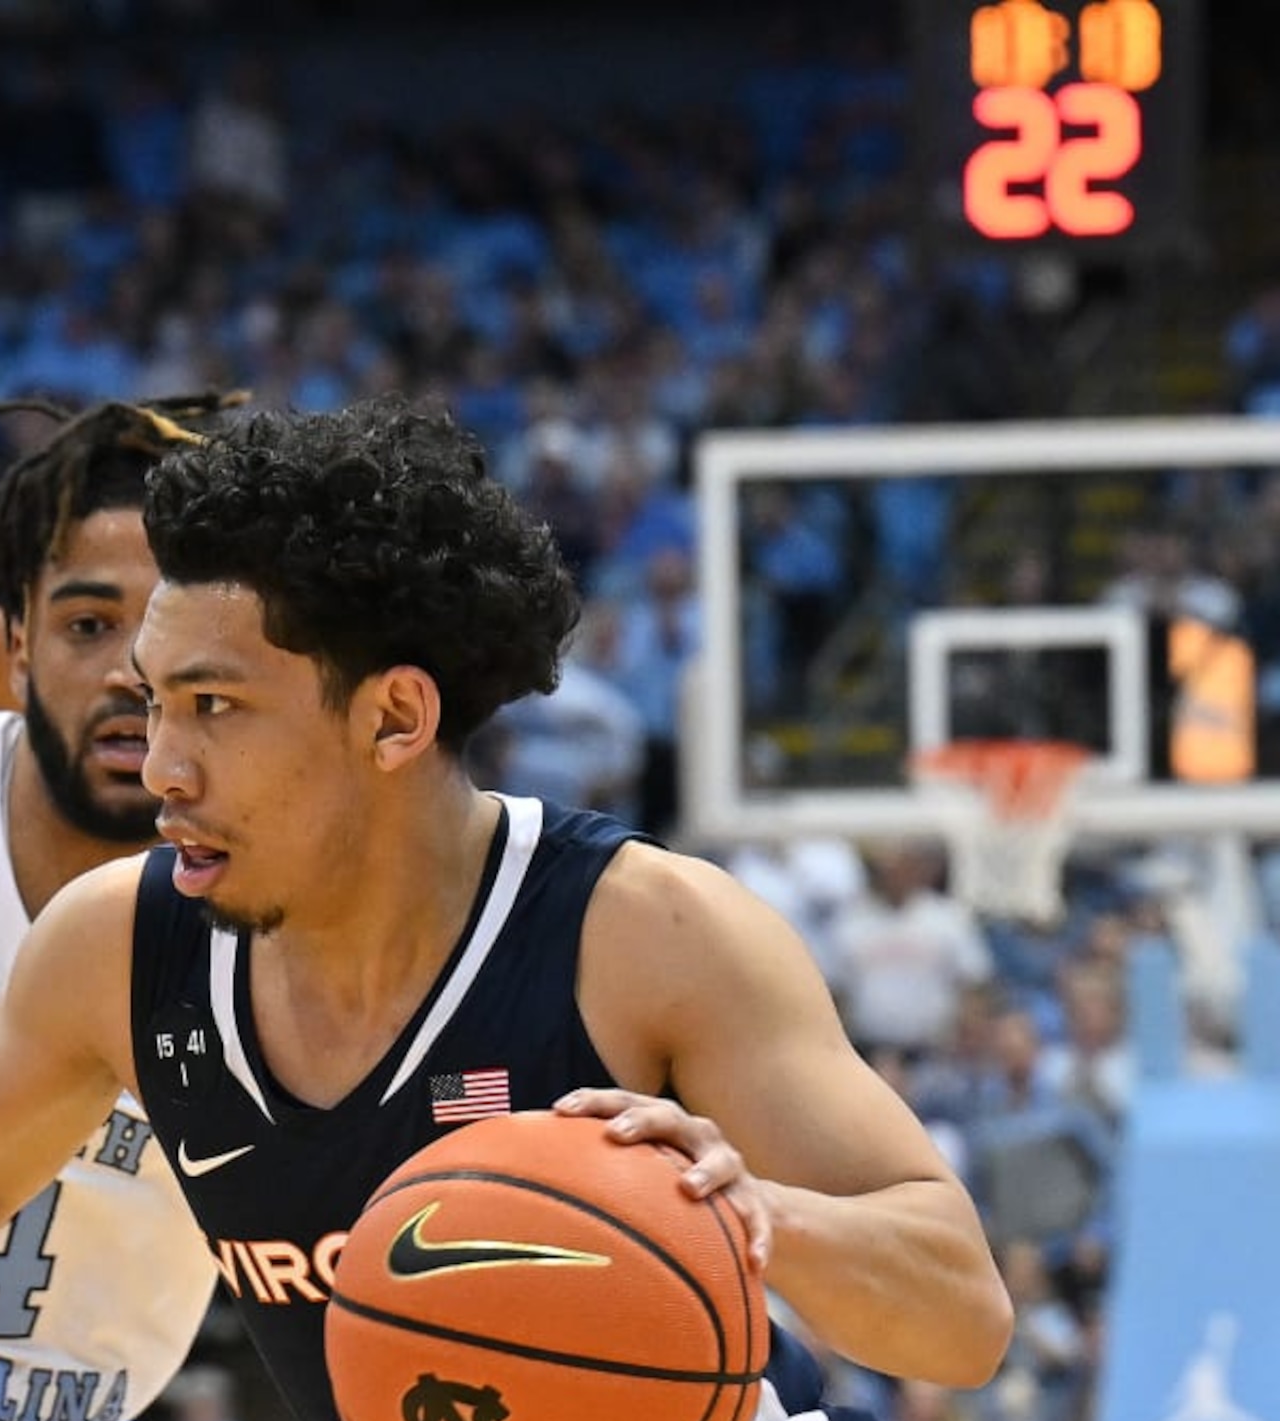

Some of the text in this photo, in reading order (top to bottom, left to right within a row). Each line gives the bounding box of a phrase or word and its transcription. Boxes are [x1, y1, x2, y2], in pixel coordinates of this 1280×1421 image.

[962, 82, 1142, 240] 22
[156, 1029, 206, 1059] 15 41
